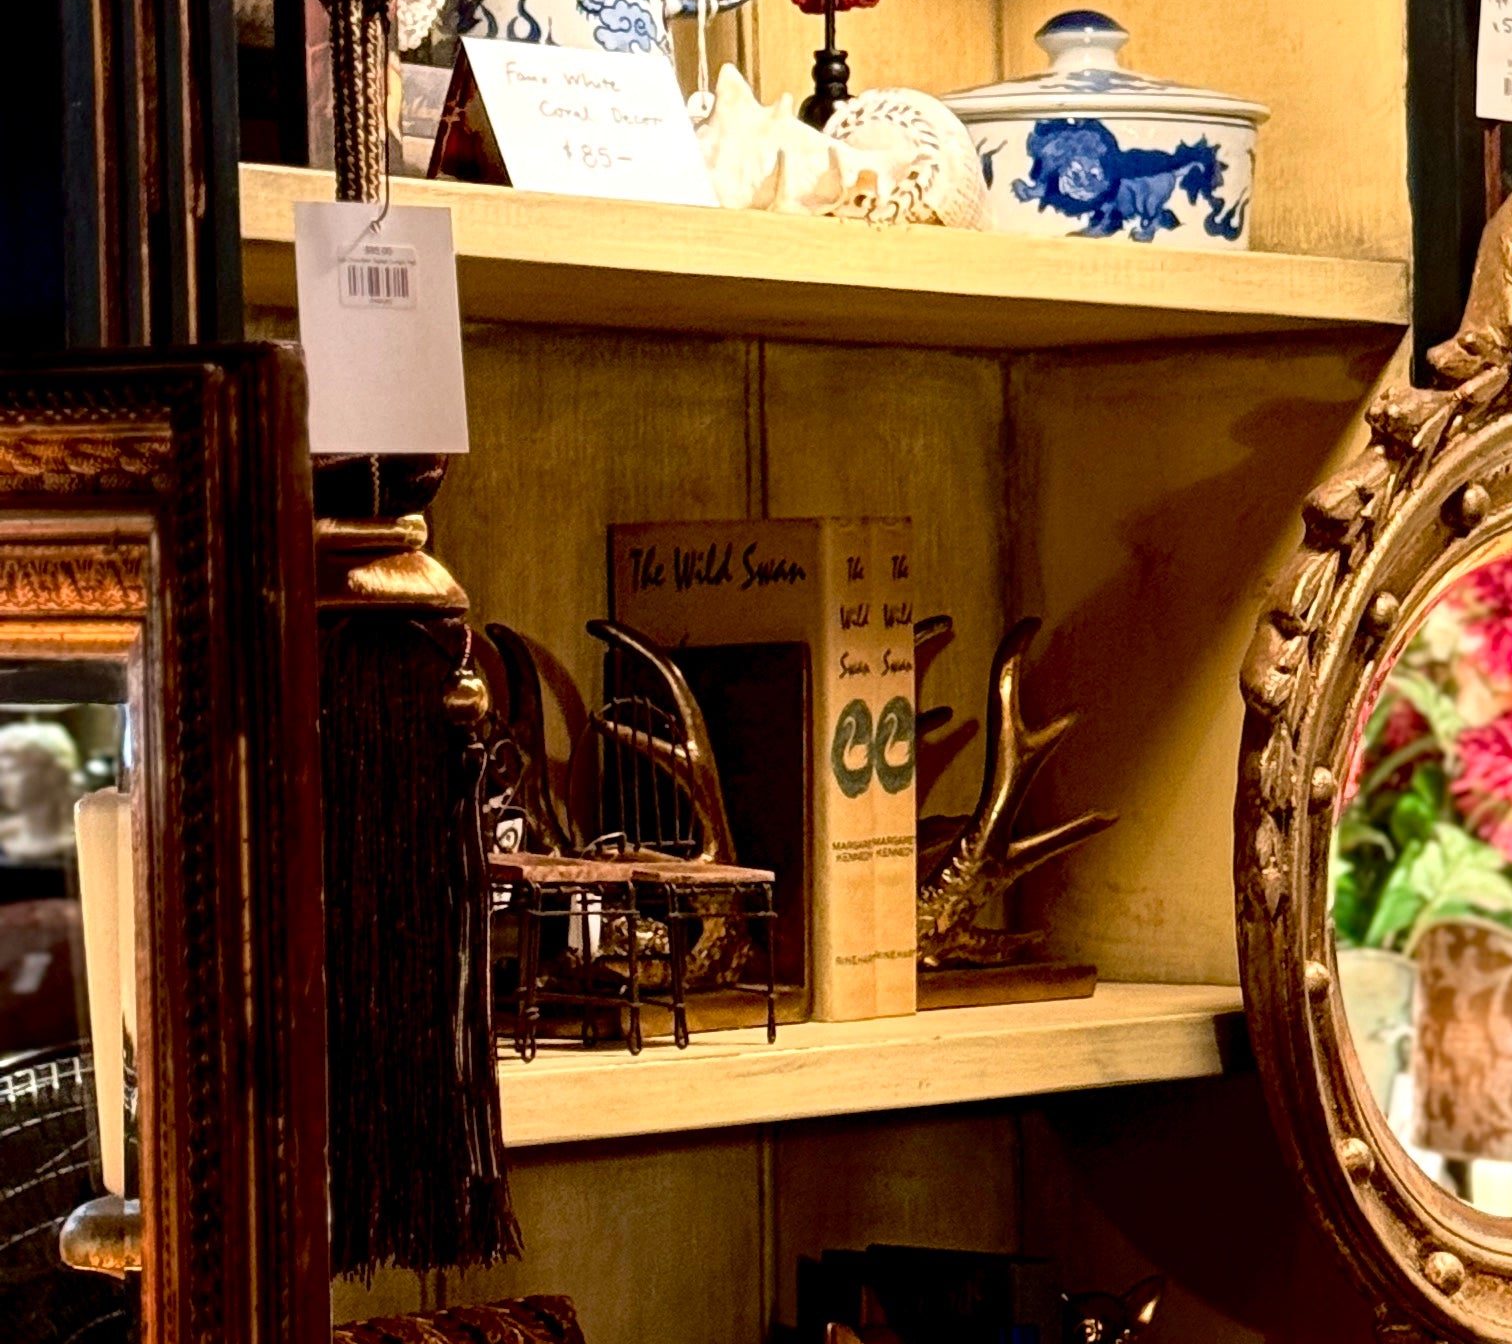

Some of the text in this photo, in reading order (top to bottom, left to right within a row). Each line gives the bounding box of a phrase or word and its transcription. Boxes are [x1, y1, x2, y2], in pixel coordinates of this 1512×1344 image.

[539, 100, 592, 122] Coral
[629, 540, 806, 593] The Wild Swan
[847, 556, 864, 582] The
[892, 554, 909, 581] The
[840, 603, 869, 630] Wild
[883, 602, 912, 629] Wild
[839, 651, 870, 678] Swan
[881, 648, 912, 676] Swan
